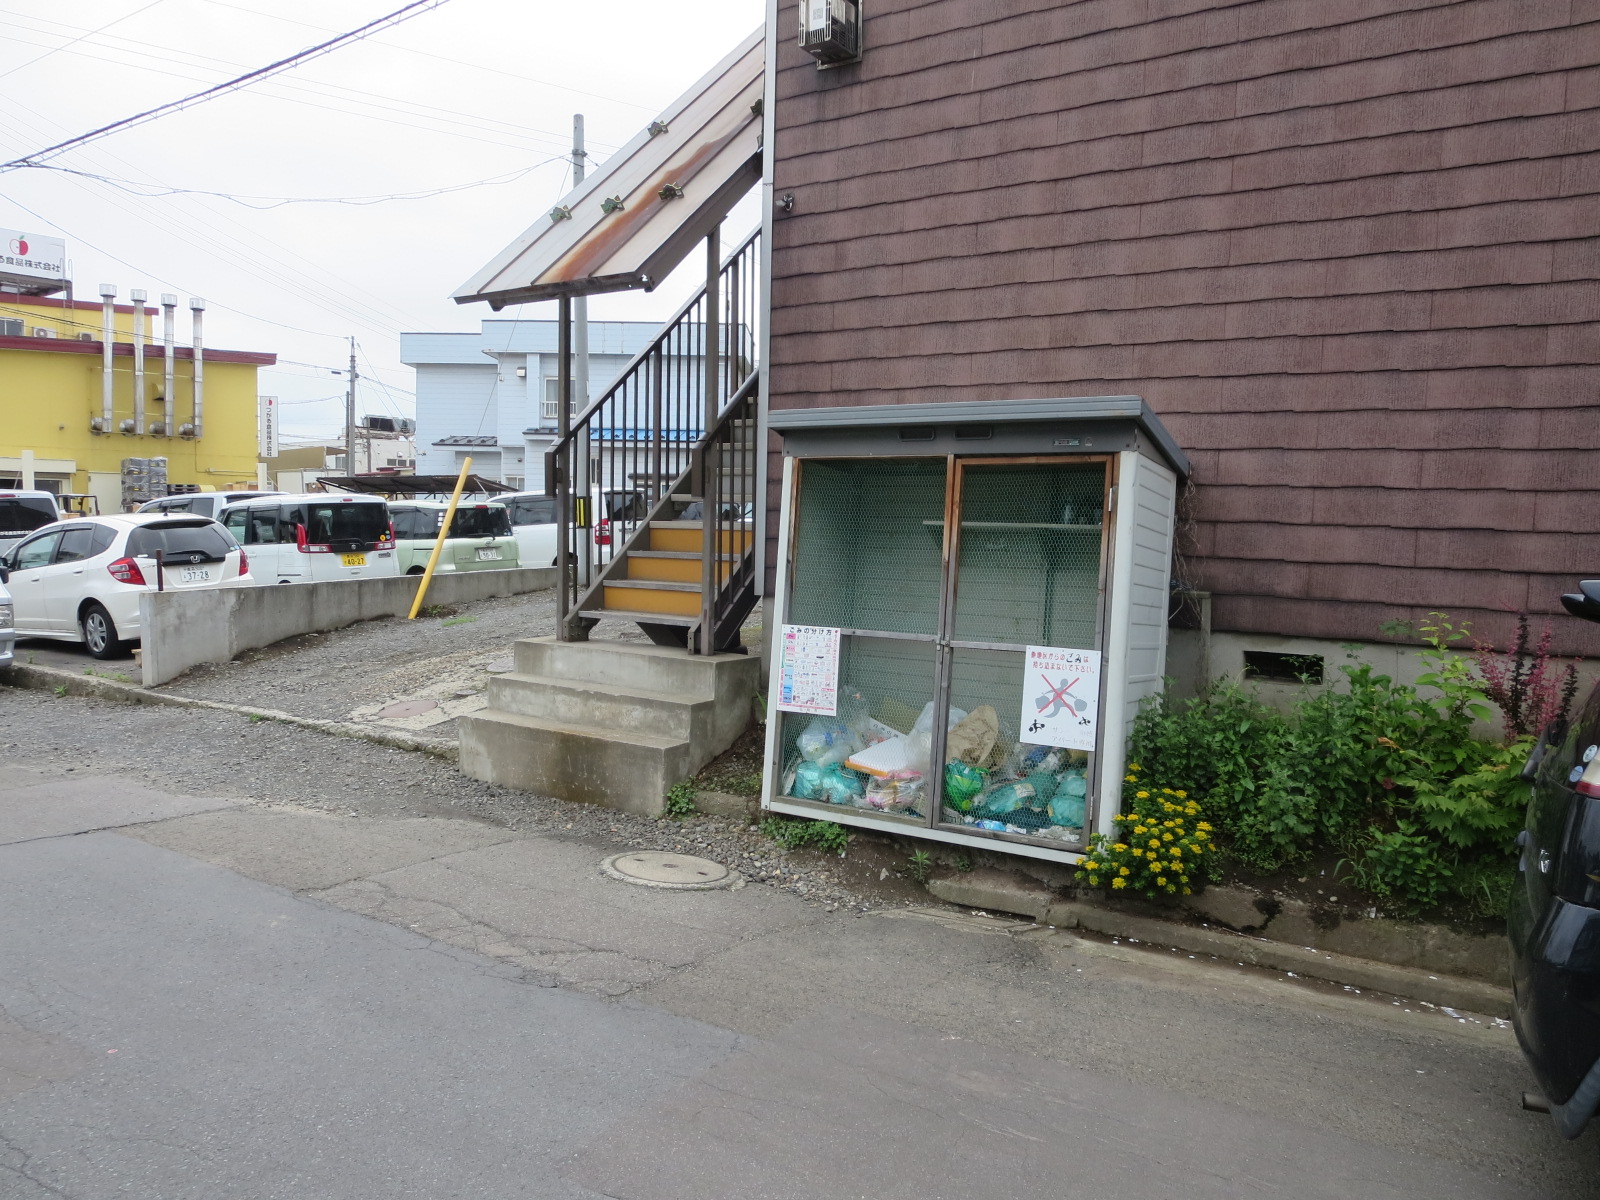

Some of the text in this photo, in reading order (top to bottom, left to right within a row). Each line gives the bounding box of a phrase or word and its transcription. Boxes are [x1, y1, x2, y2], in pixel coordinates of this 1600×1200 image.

[347, 557, 365, 566] 40-27
[187, 570, 210, 581] 37-28
[789, 626, 833, 637] ごみの分け方
